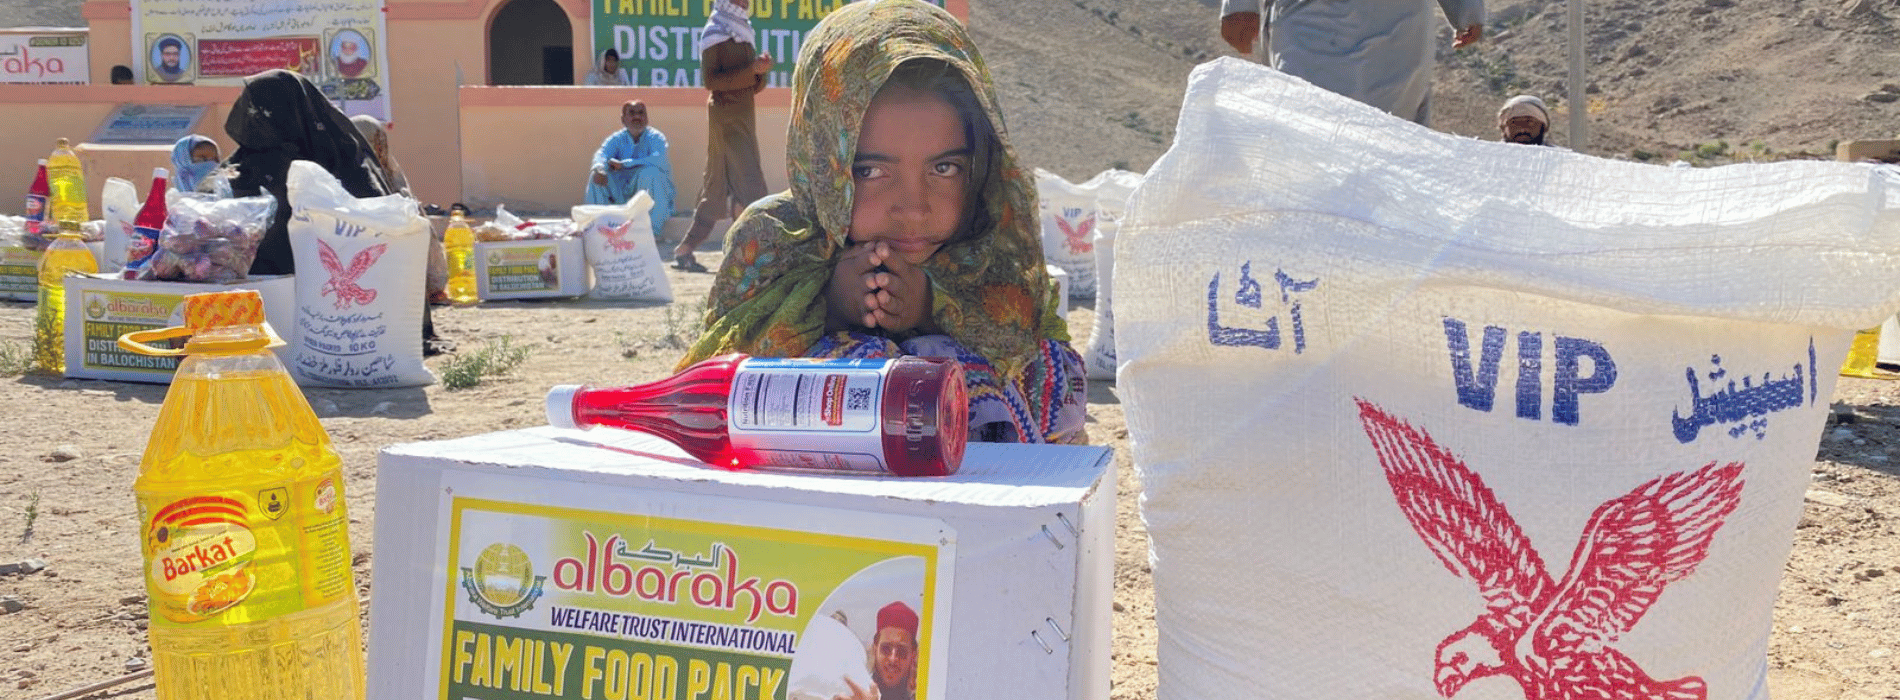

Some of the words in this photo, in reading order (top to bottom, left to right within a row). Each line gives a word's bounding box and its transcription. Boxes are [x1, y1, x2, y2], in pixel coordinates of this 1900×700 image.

[0, 45, 64, 78] aka
[1063, 206, 1082, 218] VIP
[87, 352, 98, 364] IN
[100, 353, 175, 370] BALOCHISTAN
[1442, 316, 1618, 427] VIP
[162, 536, 237, 582] Barkat
[553, 530, 798, 623] albaraka
[550, 606, 621, 635] WELFARE
[621, 616, 669, 640] TRUST
[670, 620, 797, 655] INTERNATIONAL
[453, 630, 573, 697] FAMILY
[582, 645, 679, 700] FOOD
[687, 659, 787, 700] PACK
